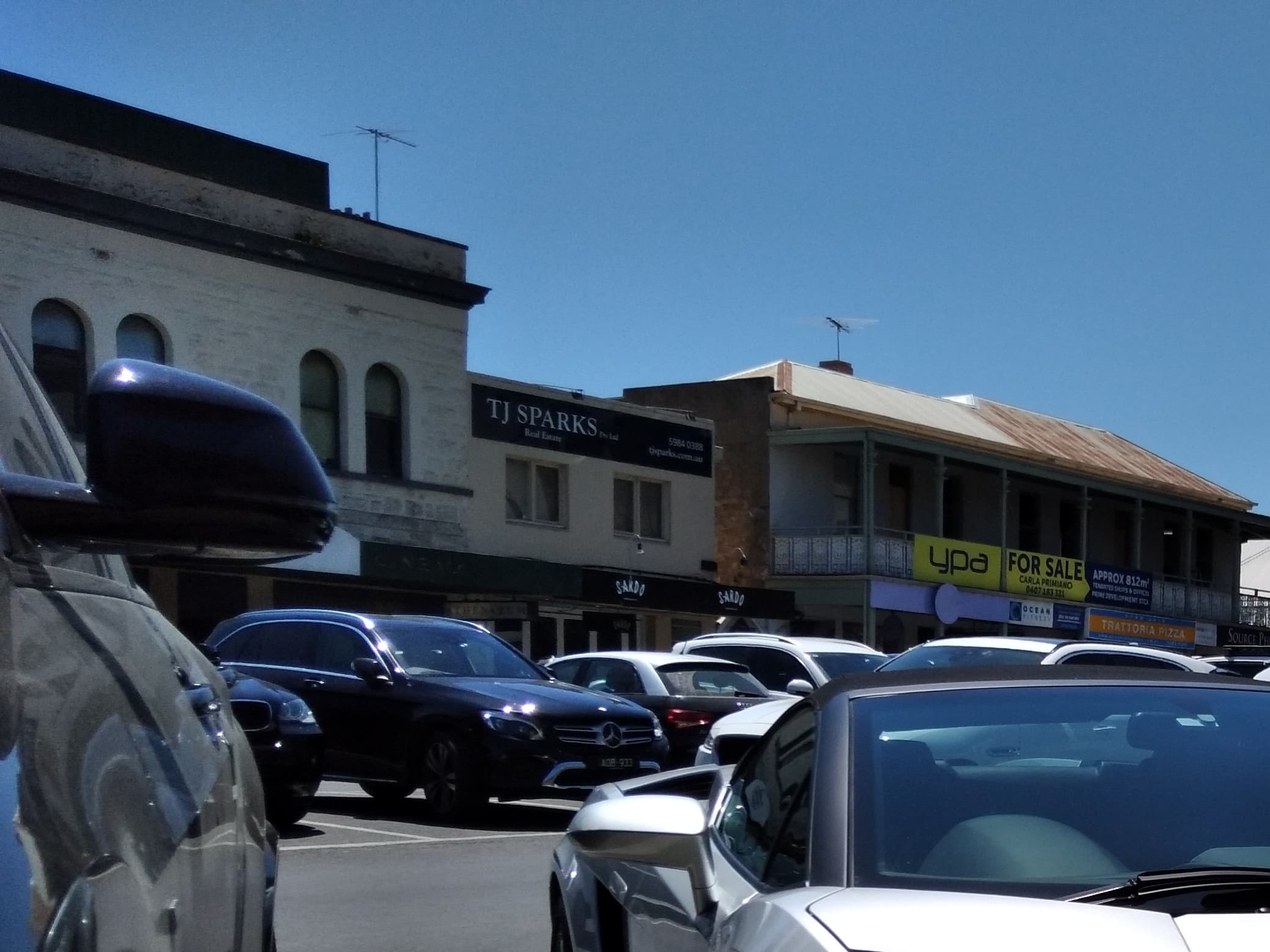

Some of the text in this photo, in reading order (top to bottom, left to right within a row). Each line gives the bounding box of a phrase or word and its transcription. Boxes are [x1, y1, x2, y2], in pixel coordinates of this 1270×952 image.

[487, 398, 510, 424] TJ
[517, 403, 598, 437] SPARKS
[525, 428, 562, 443] Real Estate
[929, 545, 989, 575] ypa
[1008, 552, 1083, 581] FOR SALE
[1019, 575, 1073, 590] CARLA PRIMIANO
[1092, 569, 1124, 585] APPROX
[615, 579, 646, 597] SARDO
[1025, 586, 1041, 595] 0407
[717, 589, 745, 607] SARDO
[1022, 605, 1051, 615] OCEAN
[1101, 619, 1155, 636] TRATTORIA
[1158, 627, 1186, 639] PIZZA
